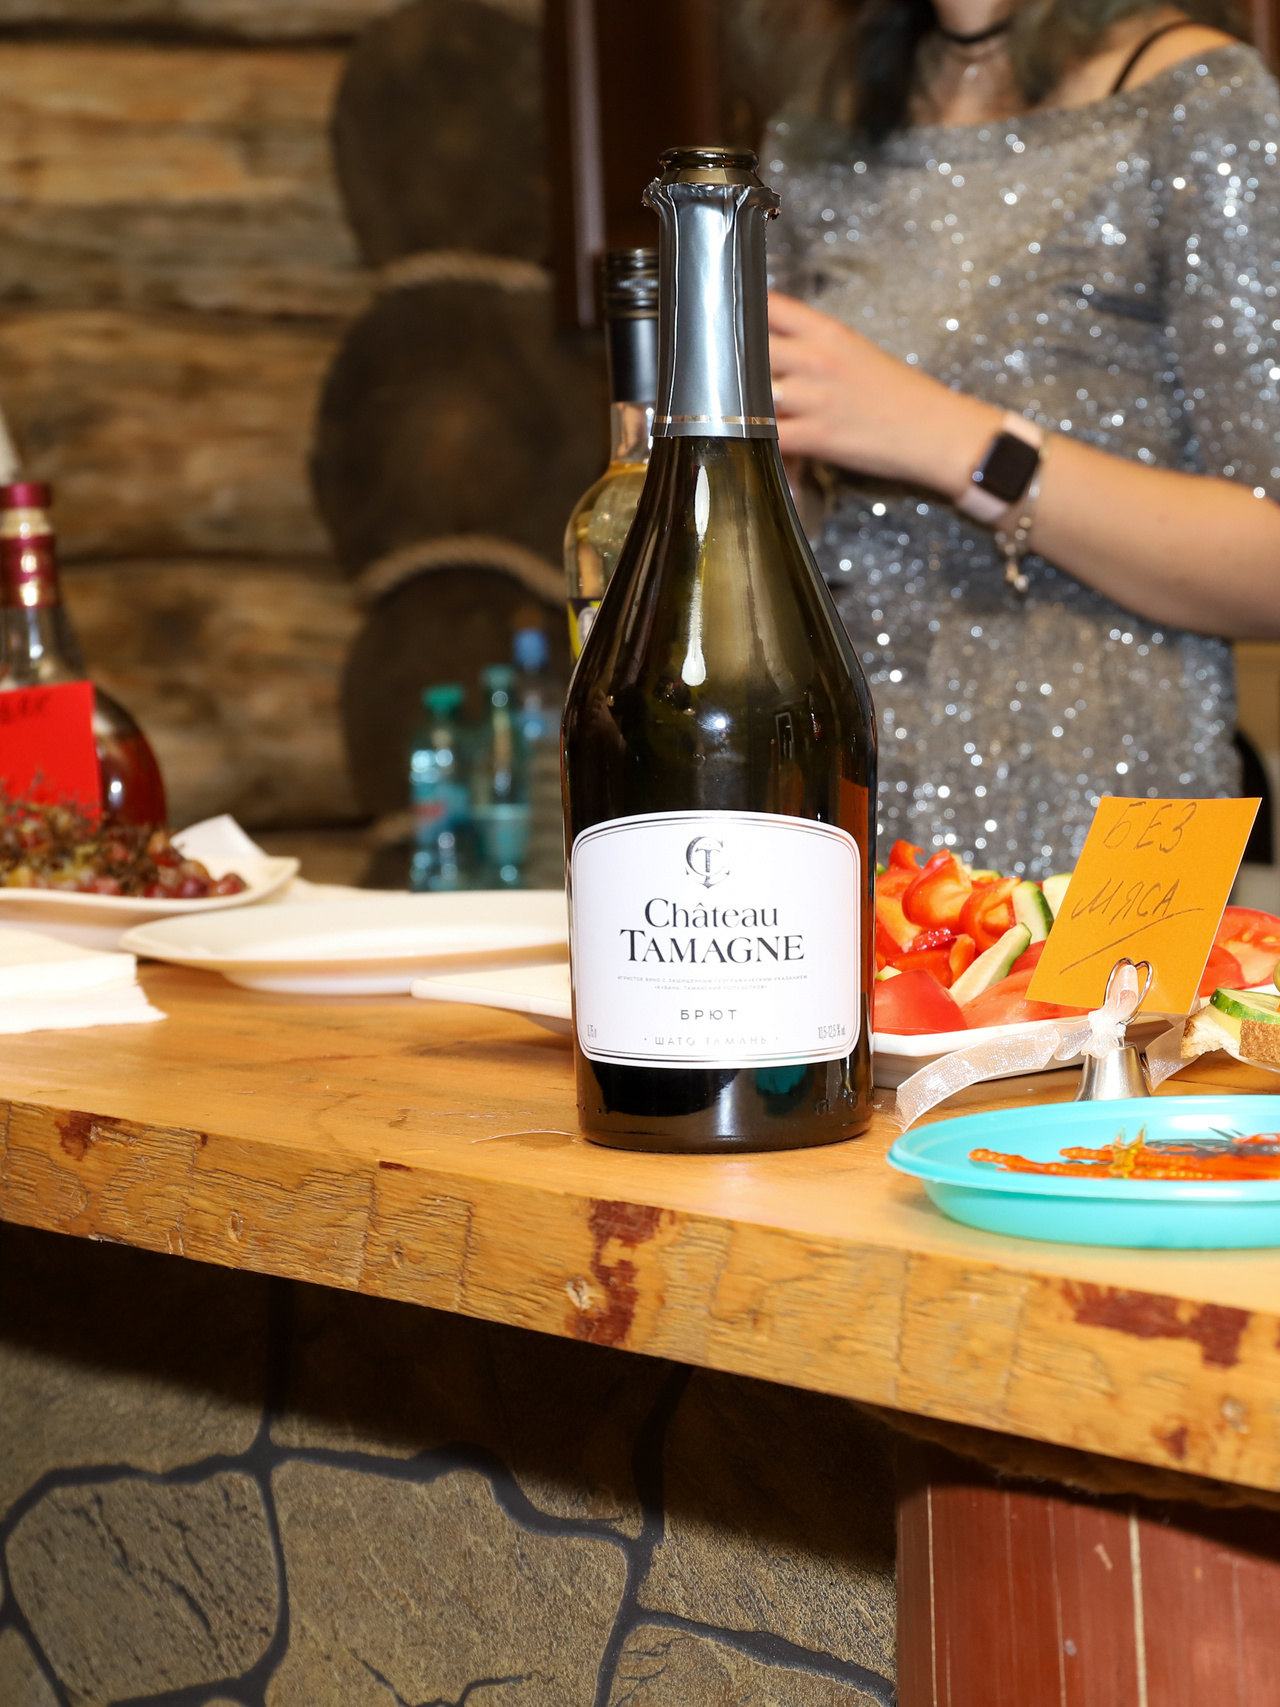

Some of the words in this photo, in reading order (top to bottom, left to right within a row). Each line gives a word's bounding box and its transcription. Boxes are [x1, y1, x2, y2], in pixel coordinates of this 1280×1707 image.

[1102, 800, 1198, 854] БЕЗ
[643, 897, 779, 928] Château
[619, 928, 806, 964] TAMAGNE
[680, 1009, 738, 1021] БРЮТ
[655, 1036, 695, 1047] ШАТО
